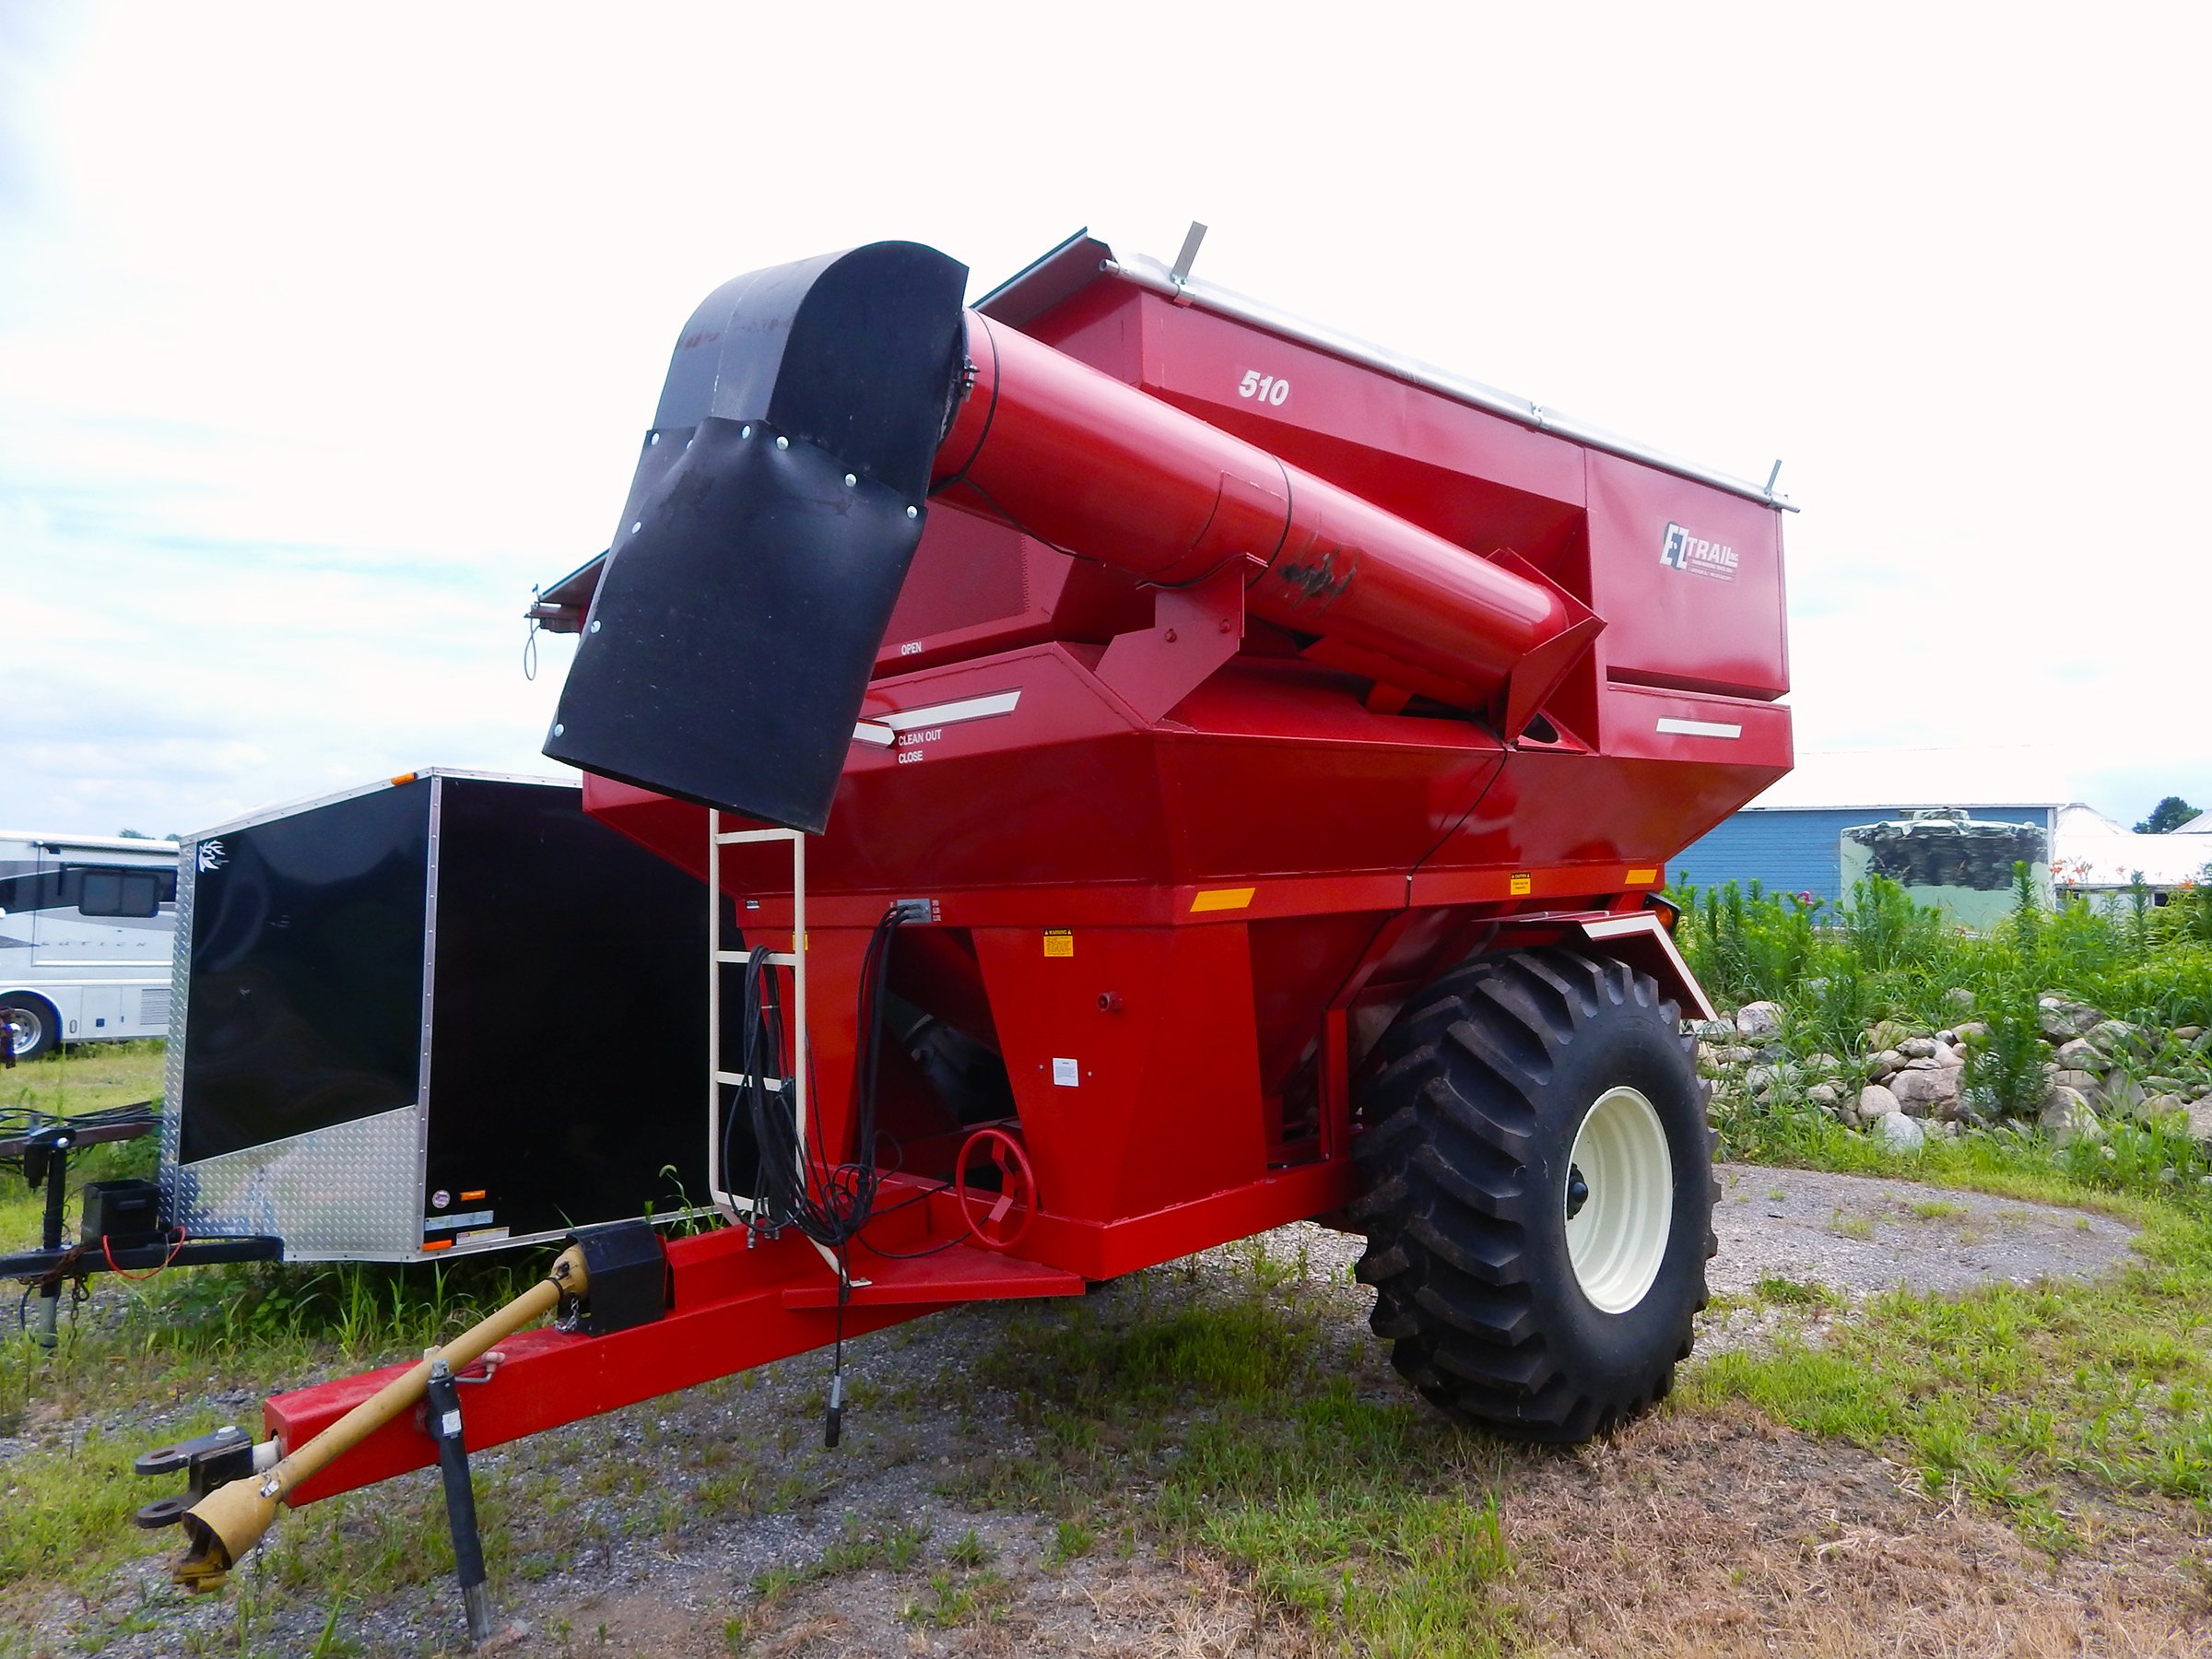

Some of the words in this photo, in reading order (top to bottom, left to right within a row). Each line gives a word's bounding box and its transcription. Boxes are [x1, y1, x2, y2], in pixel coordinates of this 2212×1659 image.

[1238, 369, 1289, 406] 510
[1687, 536, 1738, 568] TRAIL
[900, 641, 922, 655] OPEN
[898, 732, 924, 747] CLEAN
[924, 729, 942, 742] OUT
[898, 749, 924, 764] CLOSE
